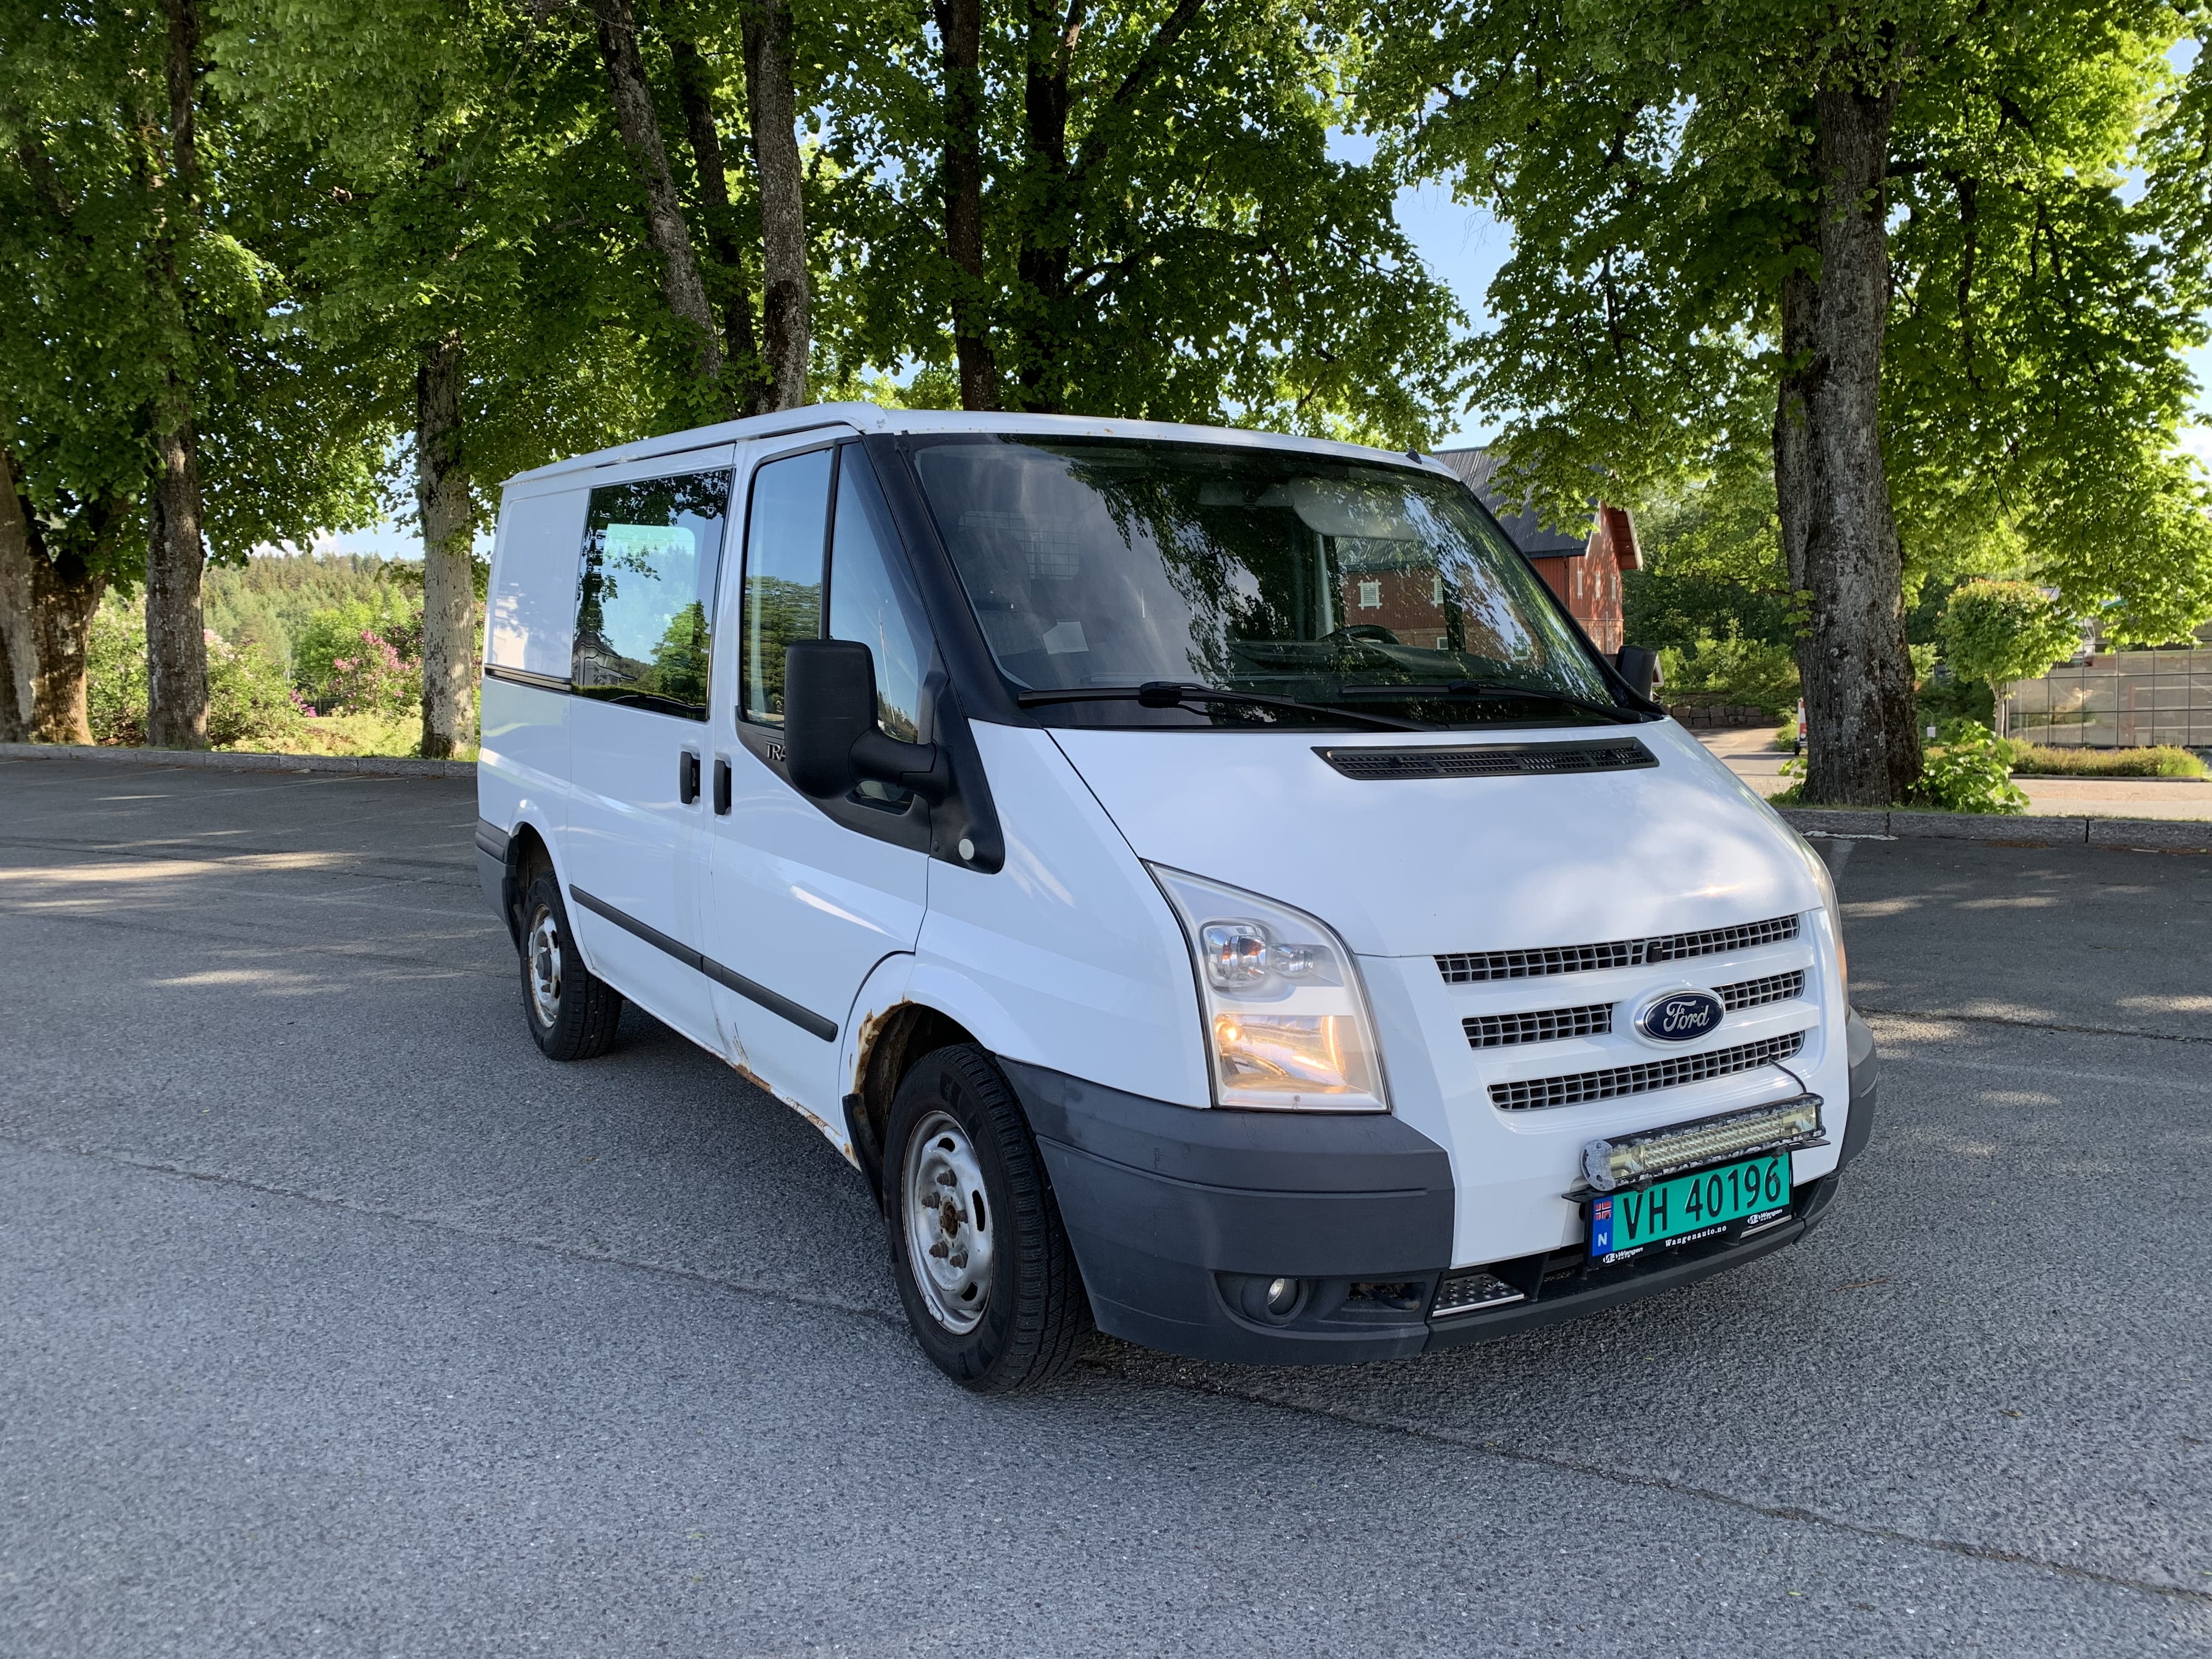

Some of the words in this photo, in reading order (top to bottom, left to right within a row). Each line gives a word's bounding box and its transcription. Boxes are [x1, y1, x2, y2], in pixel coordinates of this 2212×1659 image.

[1663, 1000, 1710, 1032] Ford
[1623, 1187, 1668, 1240] VH
[1685, 1159, 1781, 1222] 40196
[1760, 1209, 1783, 1217] Wangen
[1598, 1232, 1607, 1247] N
[1665, 1225, 1727, 1247] Wangenauto.no
[1618, 1247, 1644, 1257] Wangen
